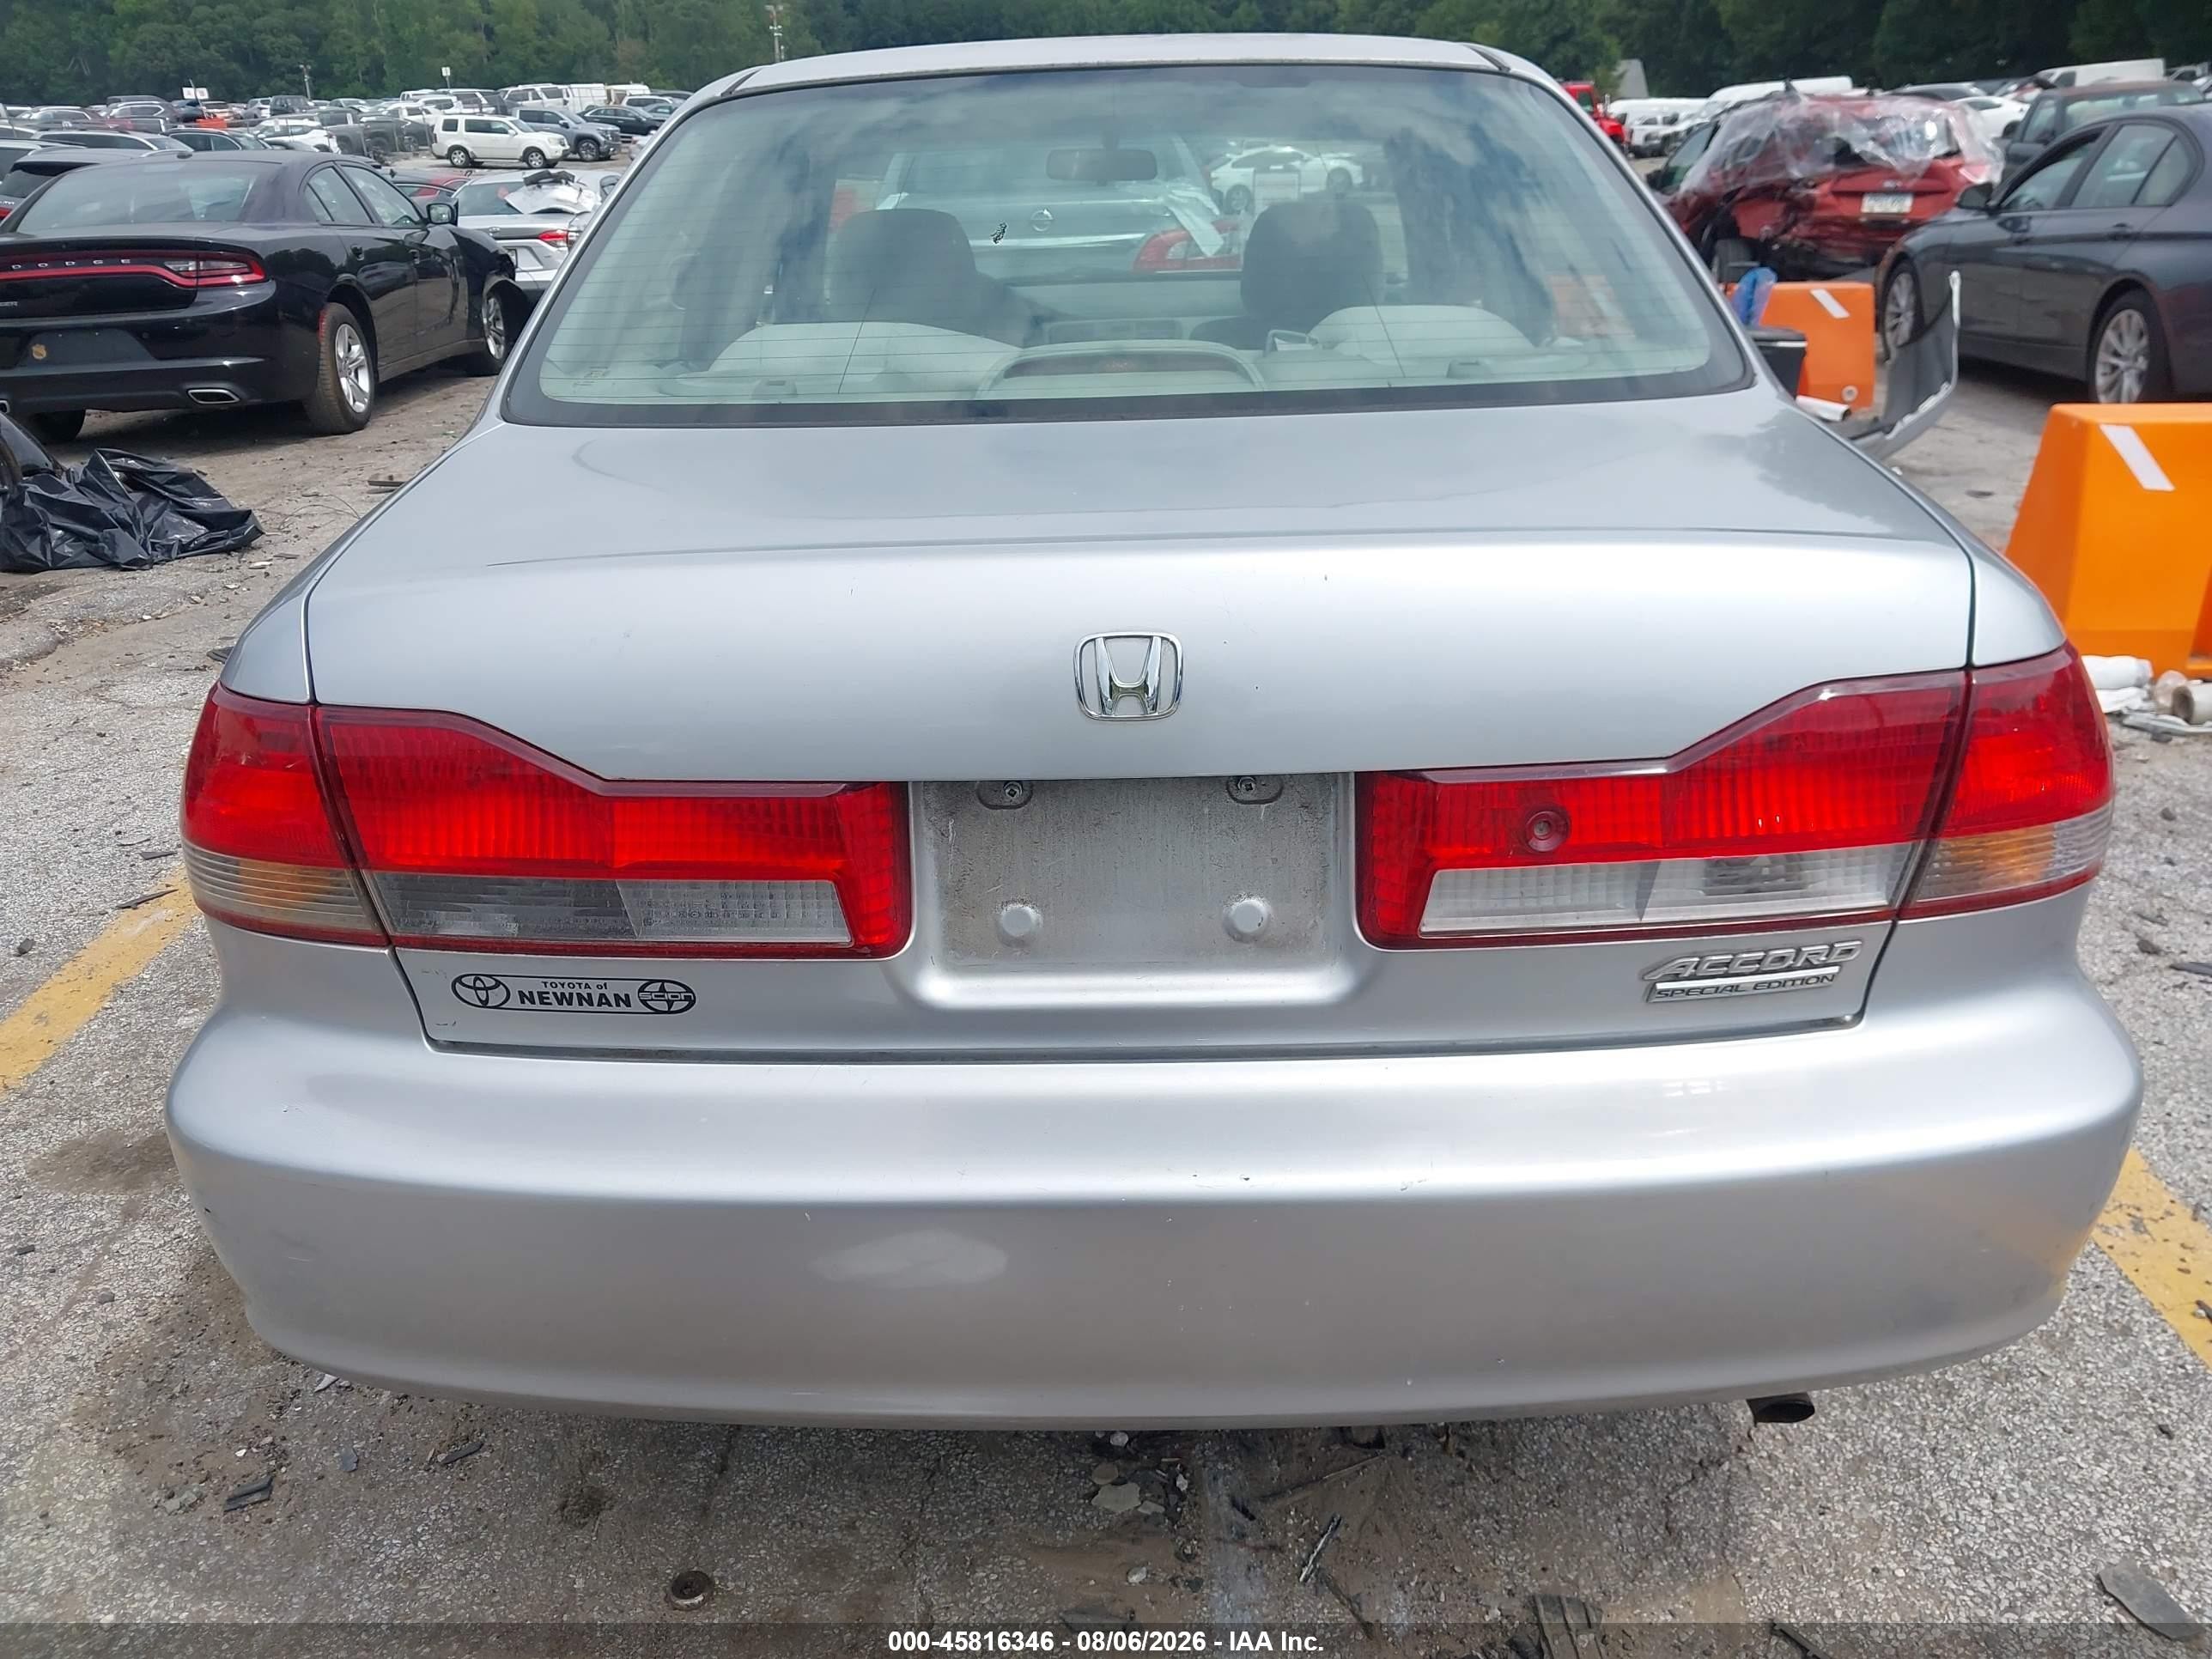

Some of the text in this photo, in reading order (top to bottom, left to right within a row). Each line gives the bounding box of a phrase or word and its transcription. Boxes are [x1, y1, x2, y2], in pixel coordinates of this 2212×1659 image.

[11, 258, 131, 270] DODGE
[1642, 940, 1862, 981] ACCORD
[541, 981, 608, 990] TOYOTA of
[1655, 974, 1836, 999] SPECIAL EDITION
[517, 989, 632, 1008] NEWNAN
